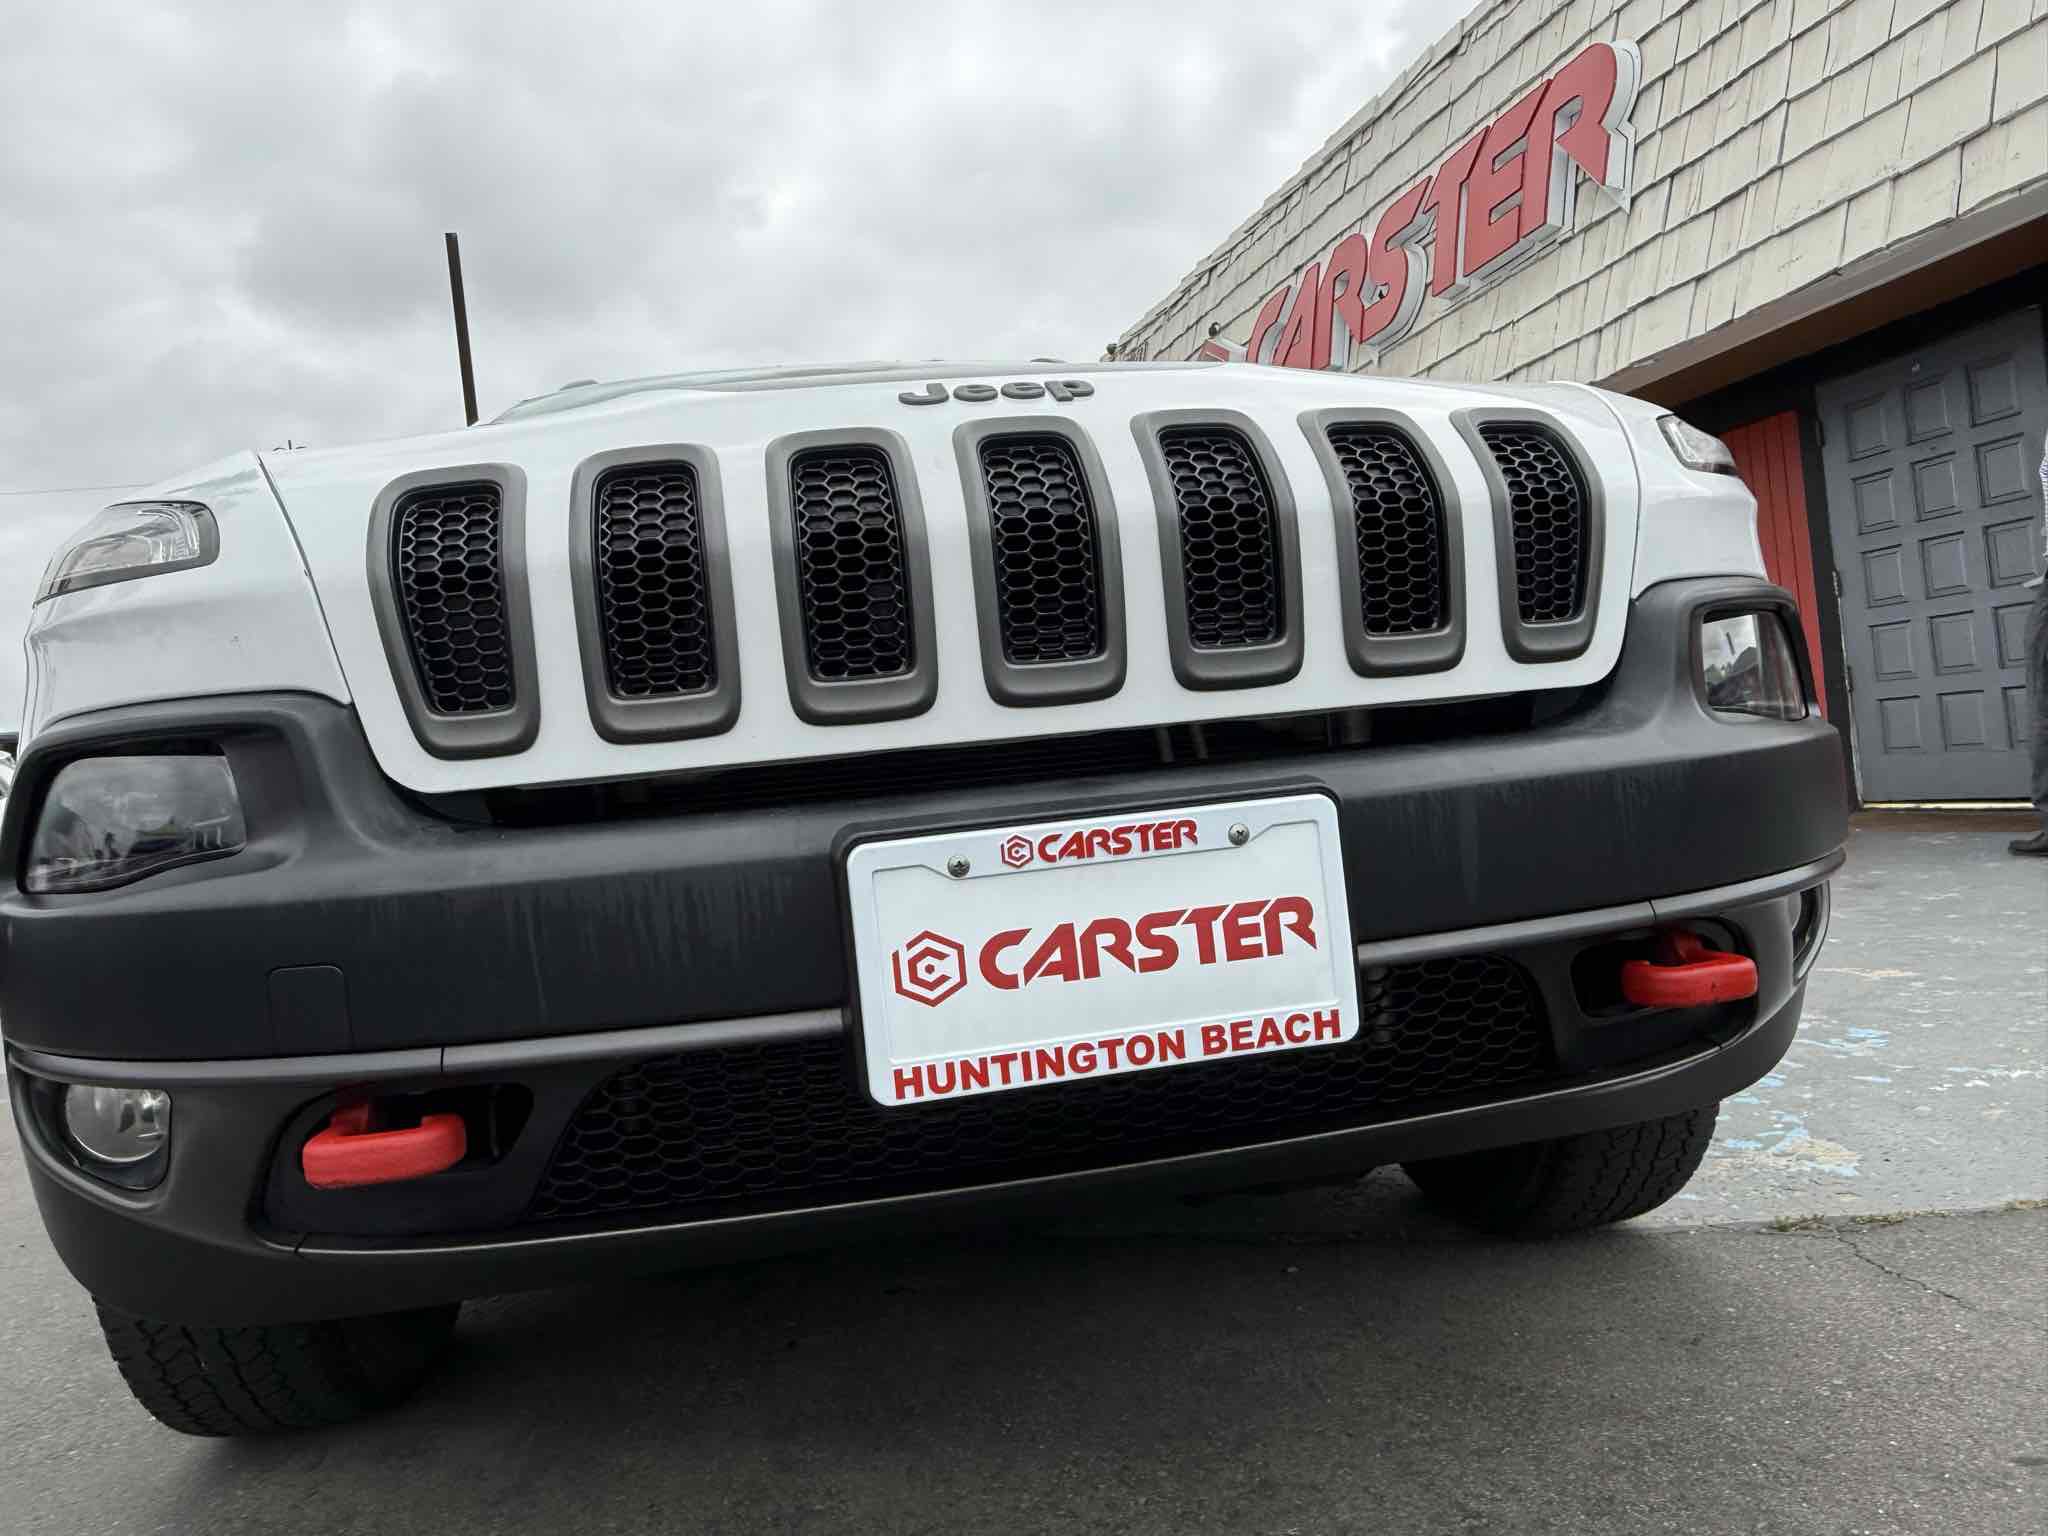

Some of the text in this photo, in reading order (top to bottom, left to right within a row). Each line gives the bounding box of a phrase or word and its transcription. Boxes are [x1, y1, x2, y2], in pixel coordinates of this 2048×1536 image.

[898, 379, 1095, 406] Jeep
[1037, 819, 1198, 862] CARSTER
[979, 896, 1317, 990] CARSTER
[893, 1009, 1342, 1100] HUNTINGTON BEACH
